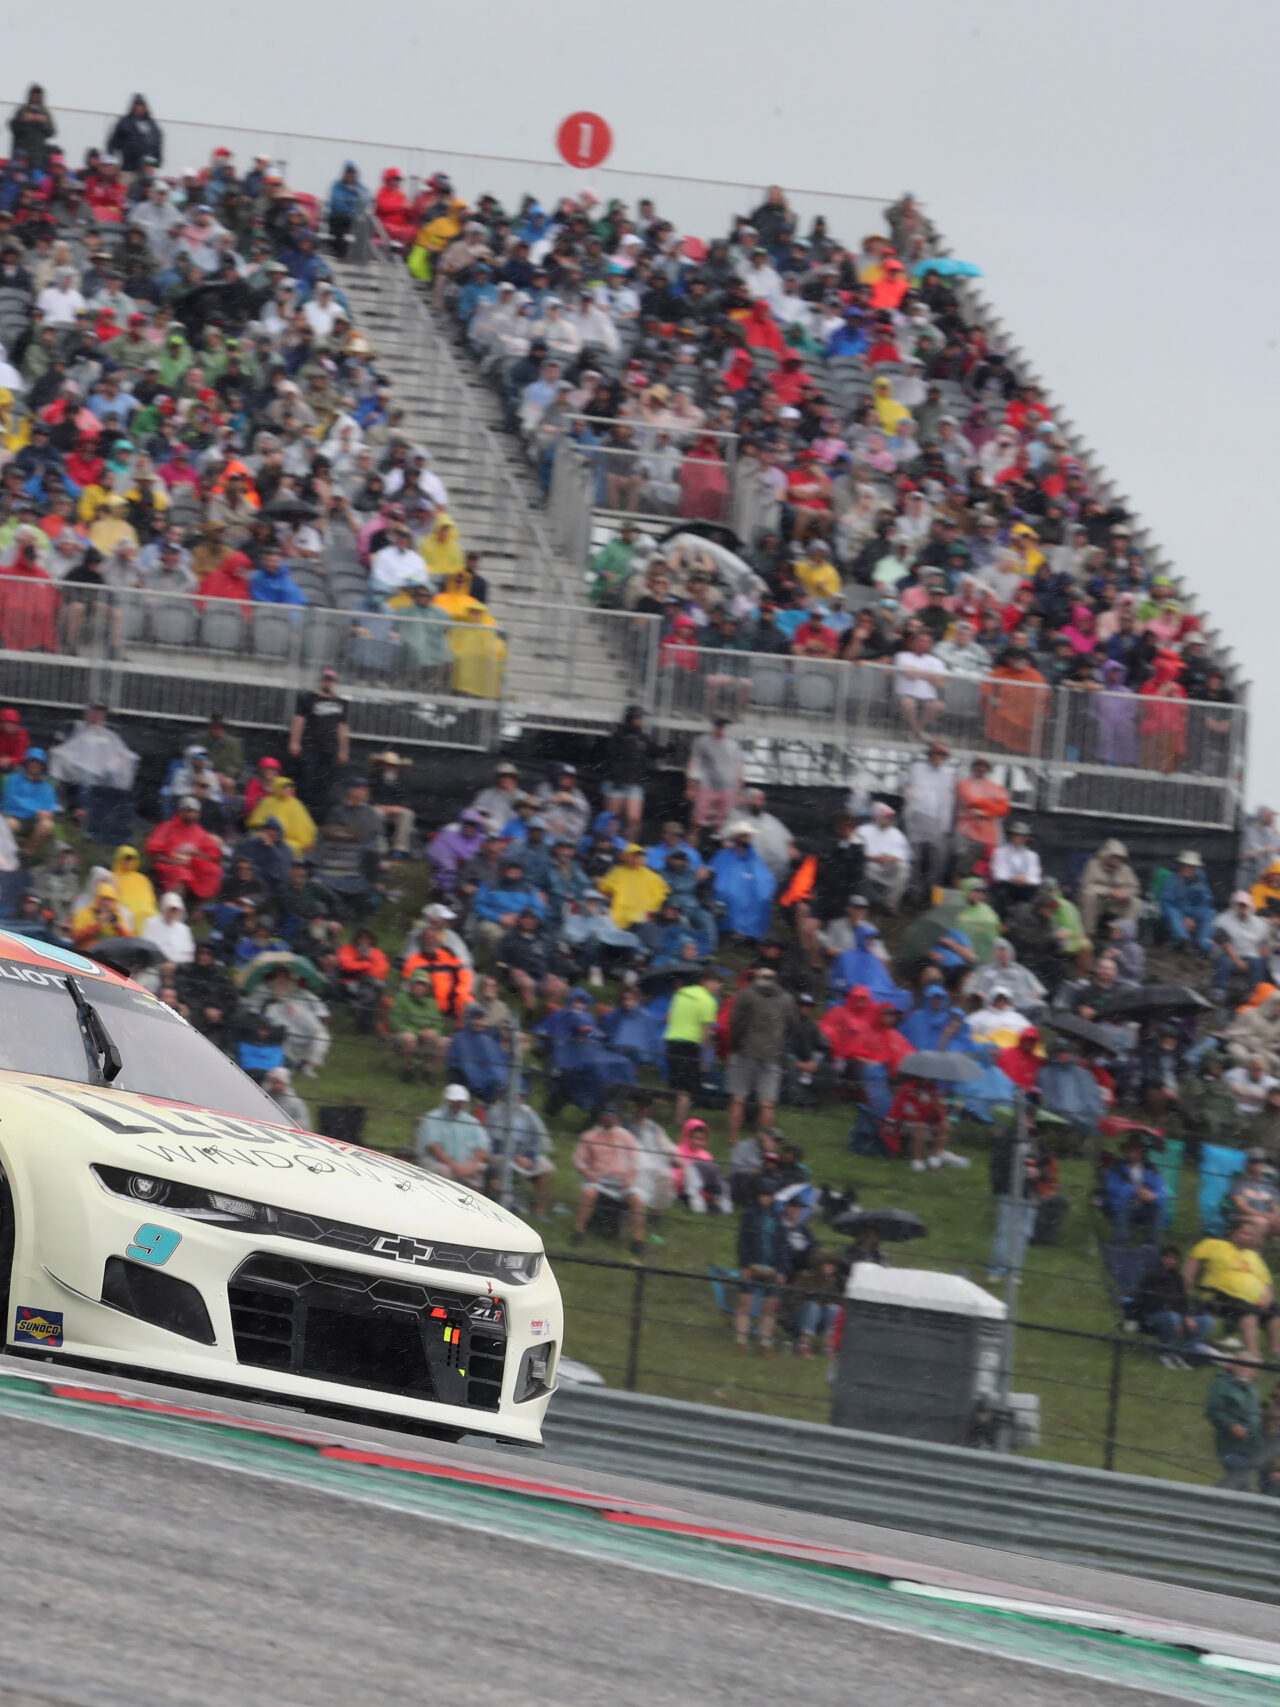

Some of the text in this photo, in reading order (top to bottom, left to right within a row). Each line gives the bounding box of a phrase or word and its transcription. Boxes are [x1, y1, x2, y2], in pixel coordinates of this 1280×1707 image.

[578, 123, 593, 158] 1
[125, 1223, 183, 1267] 9
[469, 1306, 502, 1322] ZL1
[18, 1321, 60, 1335] SUNOCO
